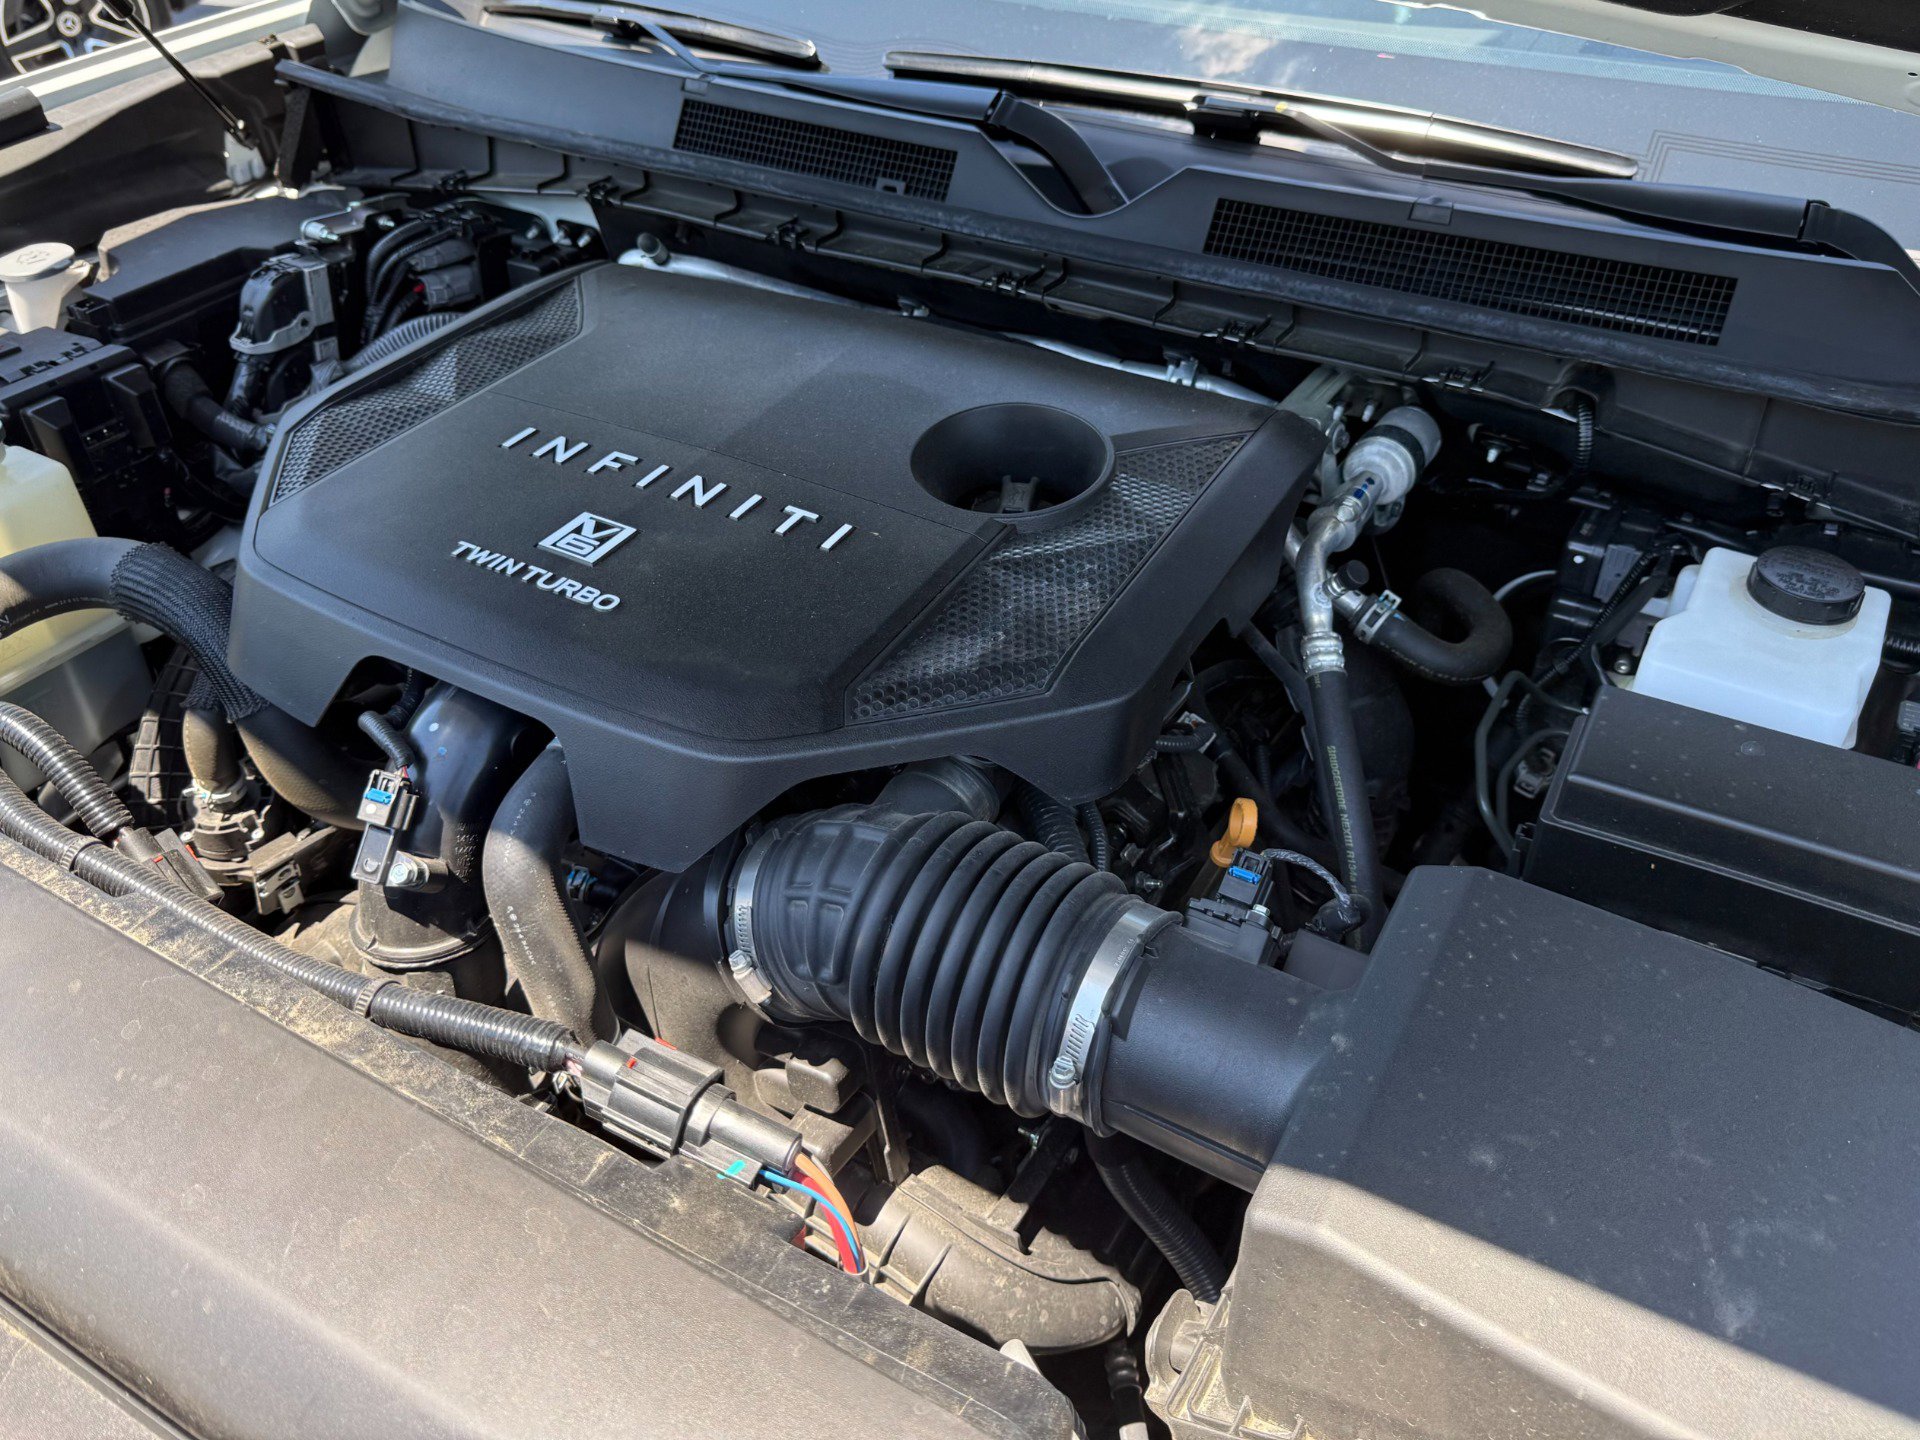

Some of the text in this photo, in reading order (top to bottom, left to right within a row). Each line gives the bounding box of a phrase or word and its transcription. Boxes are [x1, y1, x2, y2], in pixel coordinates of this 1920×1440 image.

[500, 427, 853, 552] INFINITI
[451, 540, 621, 612] TWIN TURBO
[1326, 745, 1347, 811] BRIDGESTONE
